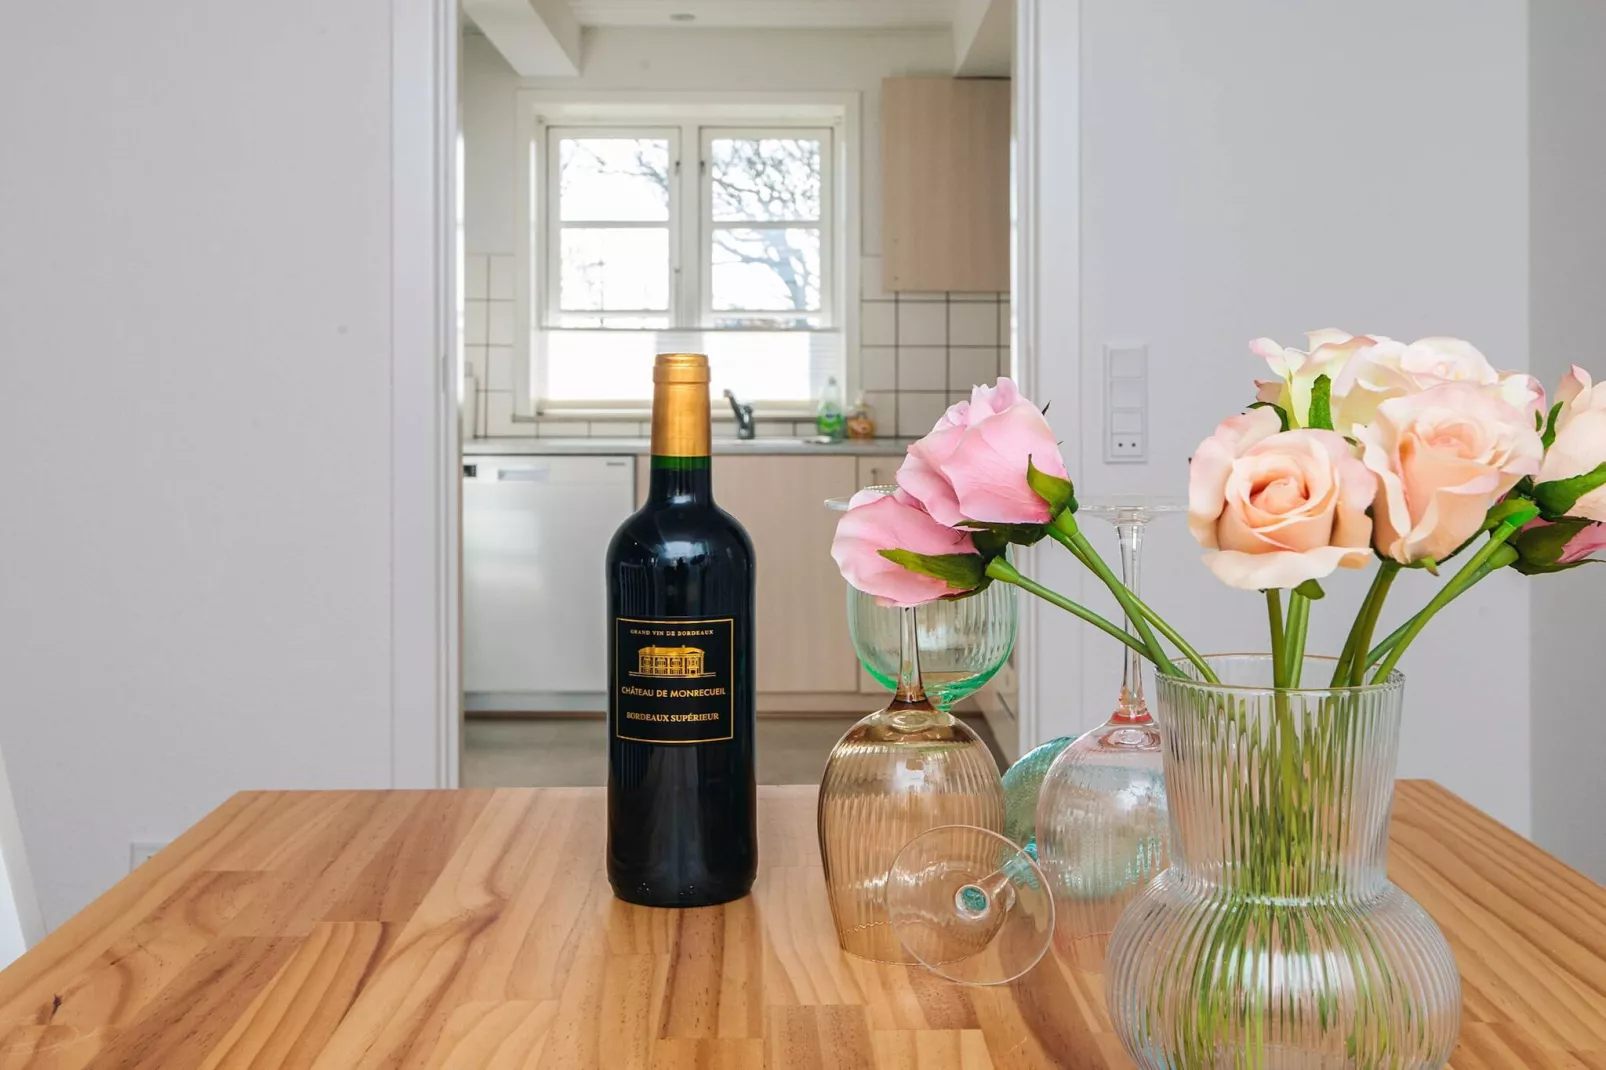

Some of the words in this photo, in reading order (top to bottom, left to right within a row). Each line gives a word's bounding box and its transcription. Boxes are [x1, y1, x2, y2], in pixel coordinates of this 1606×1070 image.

[621, 686, 654, 696] CHÂTEAU
[656, 689, 668, 697] DE
[670, 687, 726, 698] MONRECUEIL
[626, 711, 670, 722] BORDEAUX
[670, 712, 719, 722] SUPÉRIEUR
